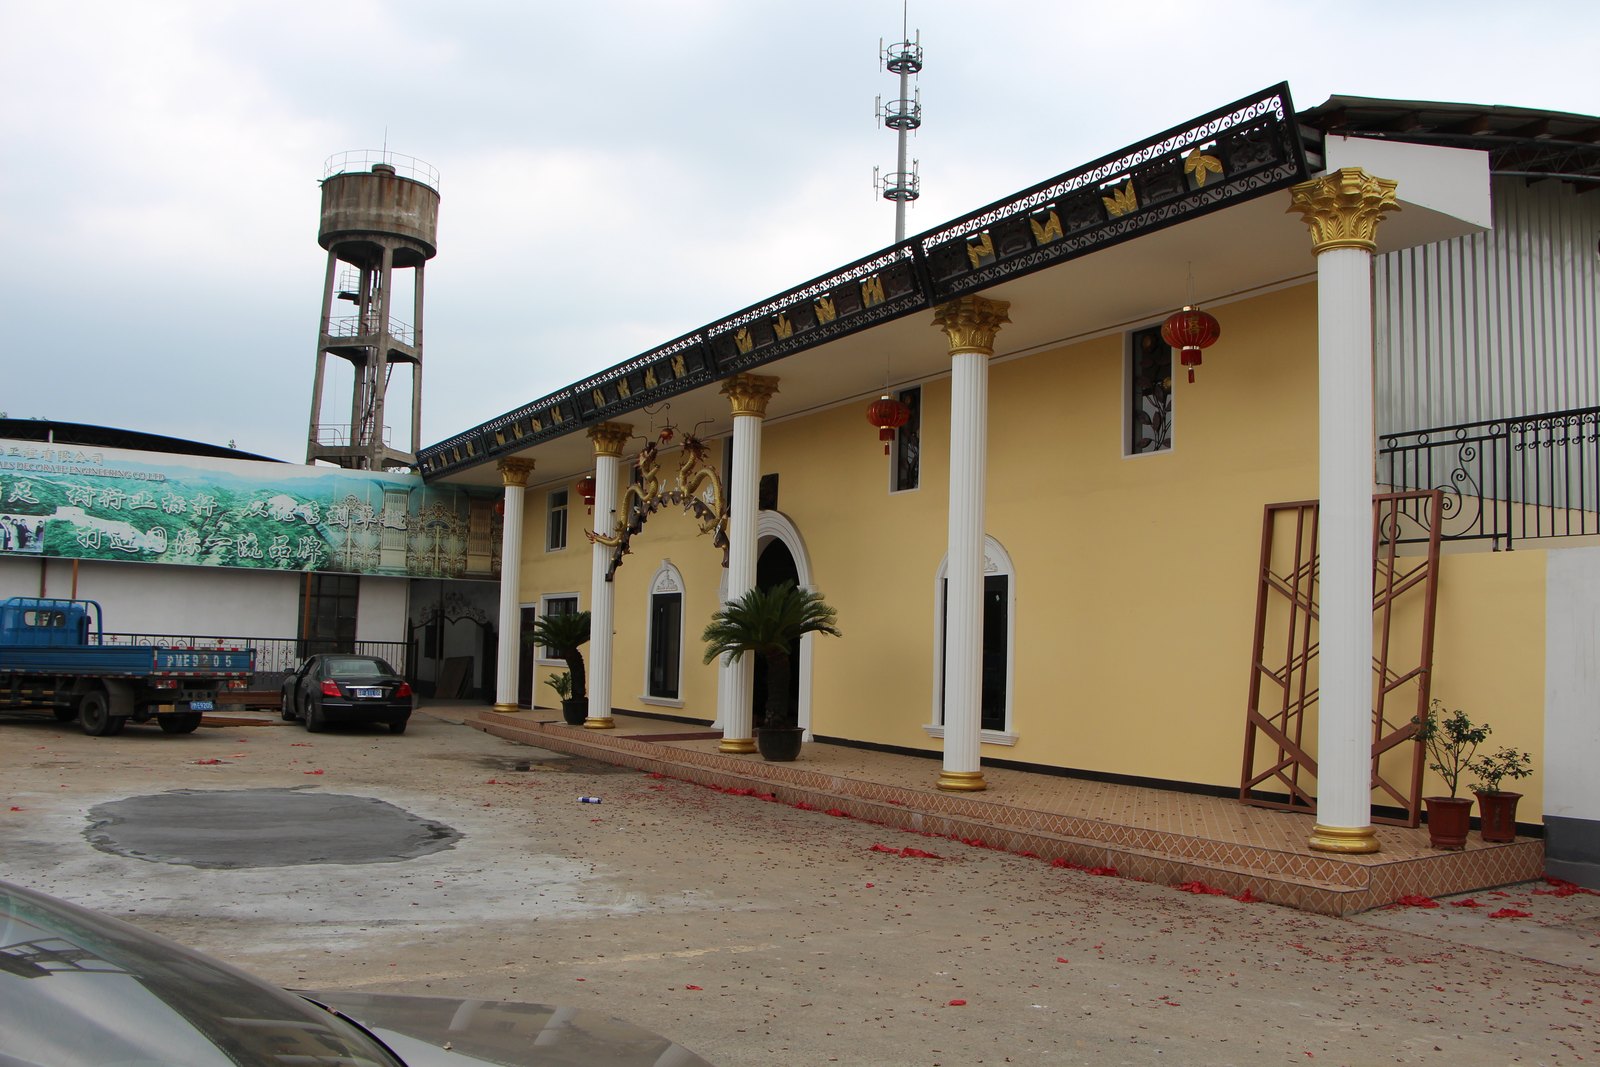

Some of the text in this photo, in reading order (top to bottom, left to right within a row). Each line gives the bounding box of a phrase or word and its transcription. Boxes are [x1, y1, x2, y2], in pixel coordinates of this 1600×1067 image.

[0, 446, 104, 466] 工程有限公司
[0, 480, 40, 504] 足
